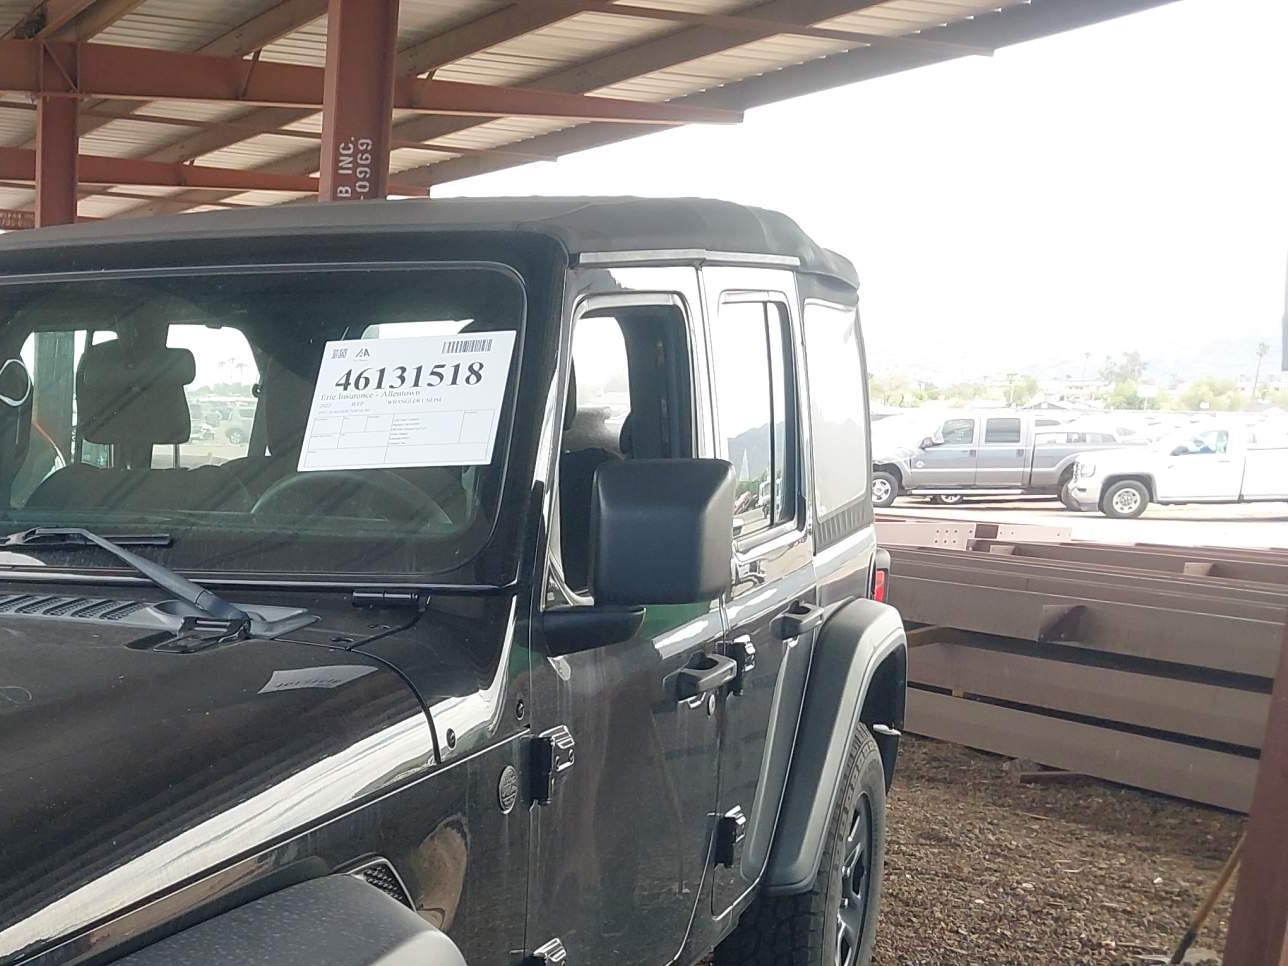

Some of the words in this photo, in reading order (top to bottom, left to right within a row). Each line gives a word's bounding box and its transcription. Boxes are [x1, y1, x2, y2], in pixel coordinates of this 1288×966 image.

[337, 136, 354, 175] INC.
[334, 361, 485, 391] 46131518
[320, 393, 337, 401] Erie
[338, 391, 374, 400] Insurance
[381, 389, 421, 398] Allentown
